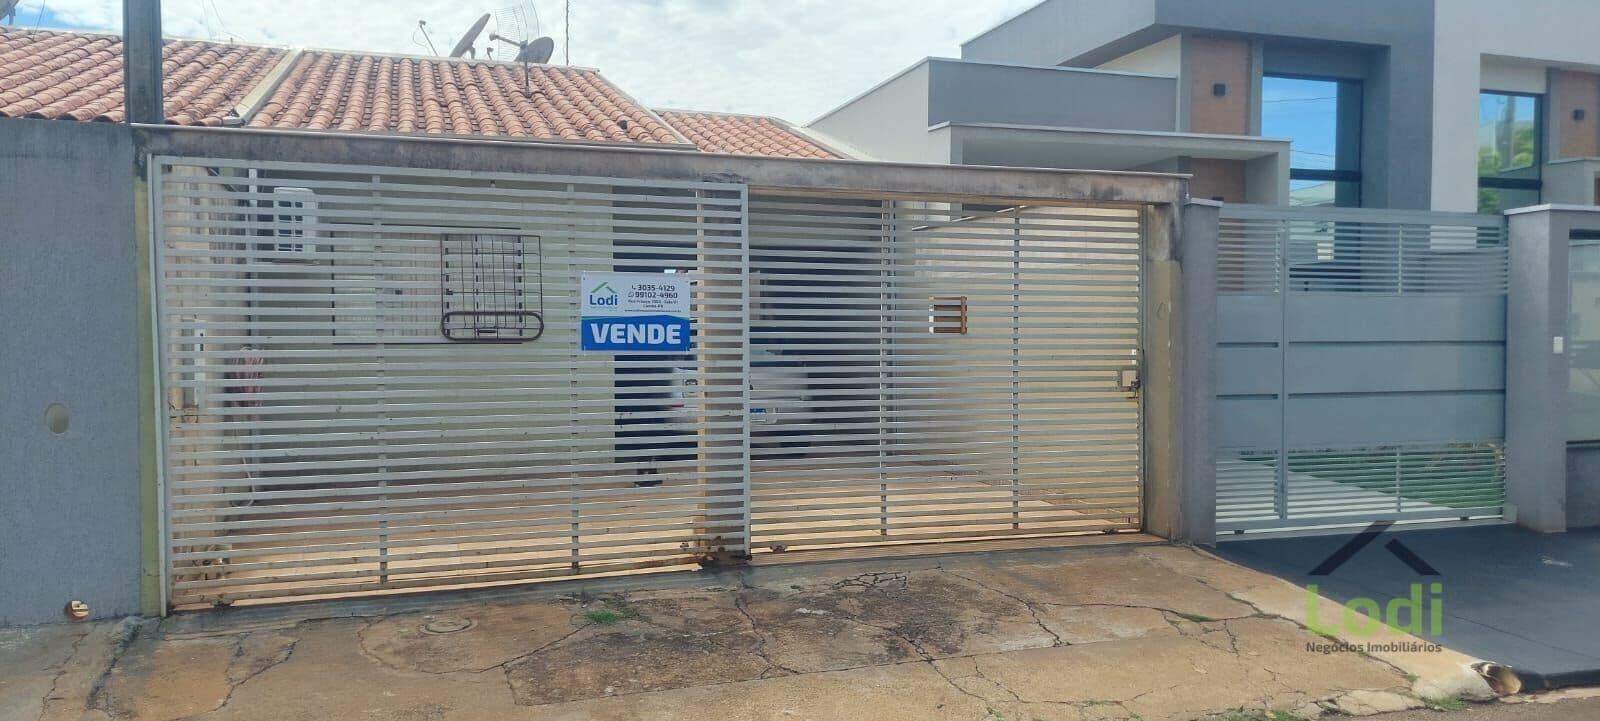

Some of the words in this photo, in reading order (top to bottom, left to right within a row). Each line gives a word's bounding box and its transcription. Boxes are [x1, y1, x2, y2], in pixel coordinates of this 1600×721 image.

[590, 294, 618, 306] Lodi
[635, 291, 678, 299] 99102-4960
[590, 323, 681, 344] VENDE
